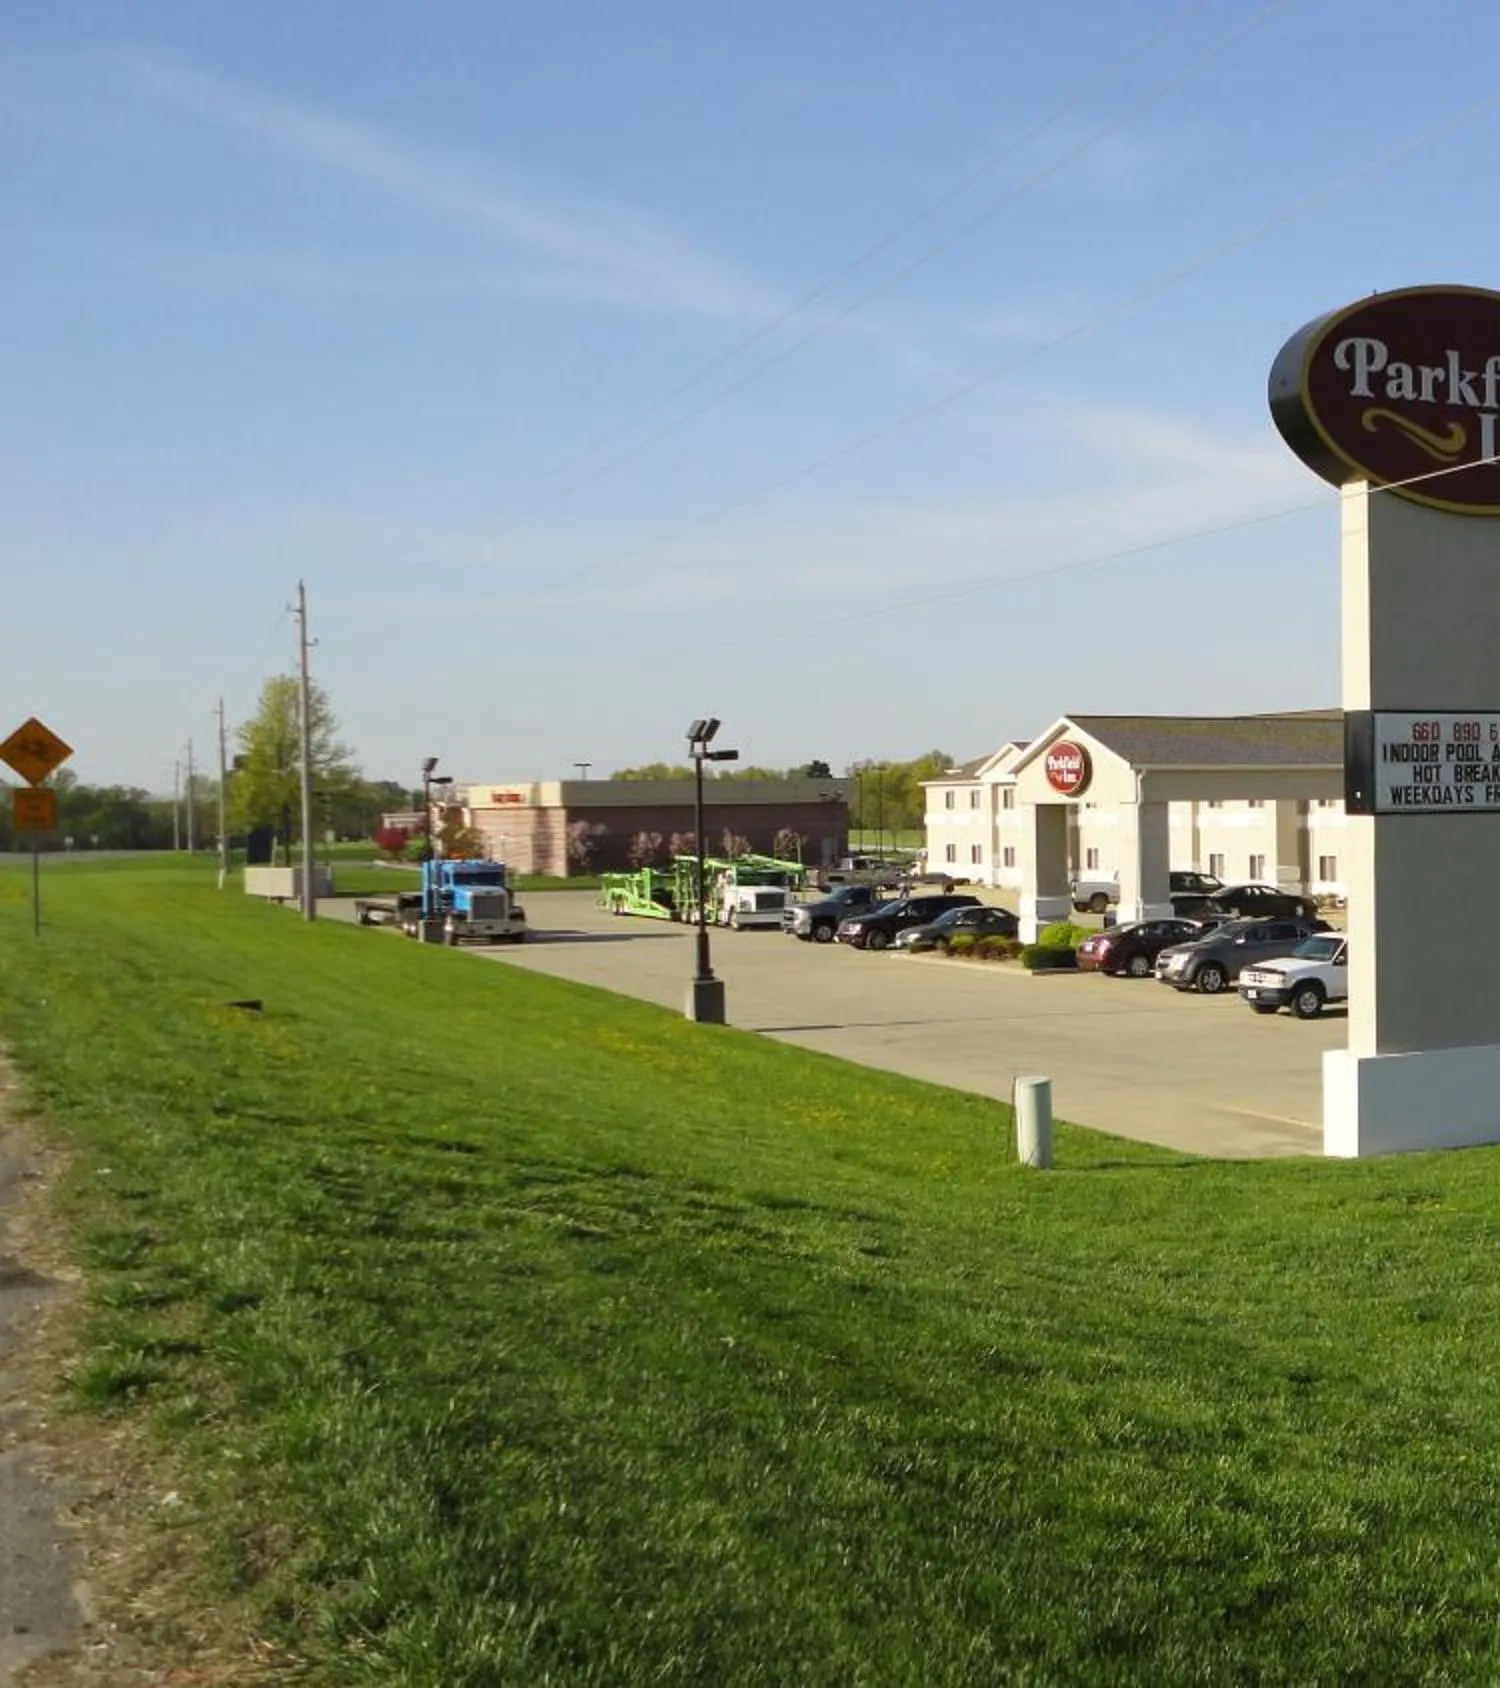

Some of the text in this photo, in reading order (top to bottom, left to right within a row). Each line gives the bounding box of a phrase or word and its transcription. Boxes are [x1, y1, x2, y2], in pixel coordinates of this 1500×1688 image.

[1412, 721, 1441, 741] 660
[1383, 743, 1439, 762] INDOOR
[1446, 743, 1484, 762] POOL
[1413, 764, 1442, 783] HOT
[1390, 785, 1474, 805] WEEKDAYS
